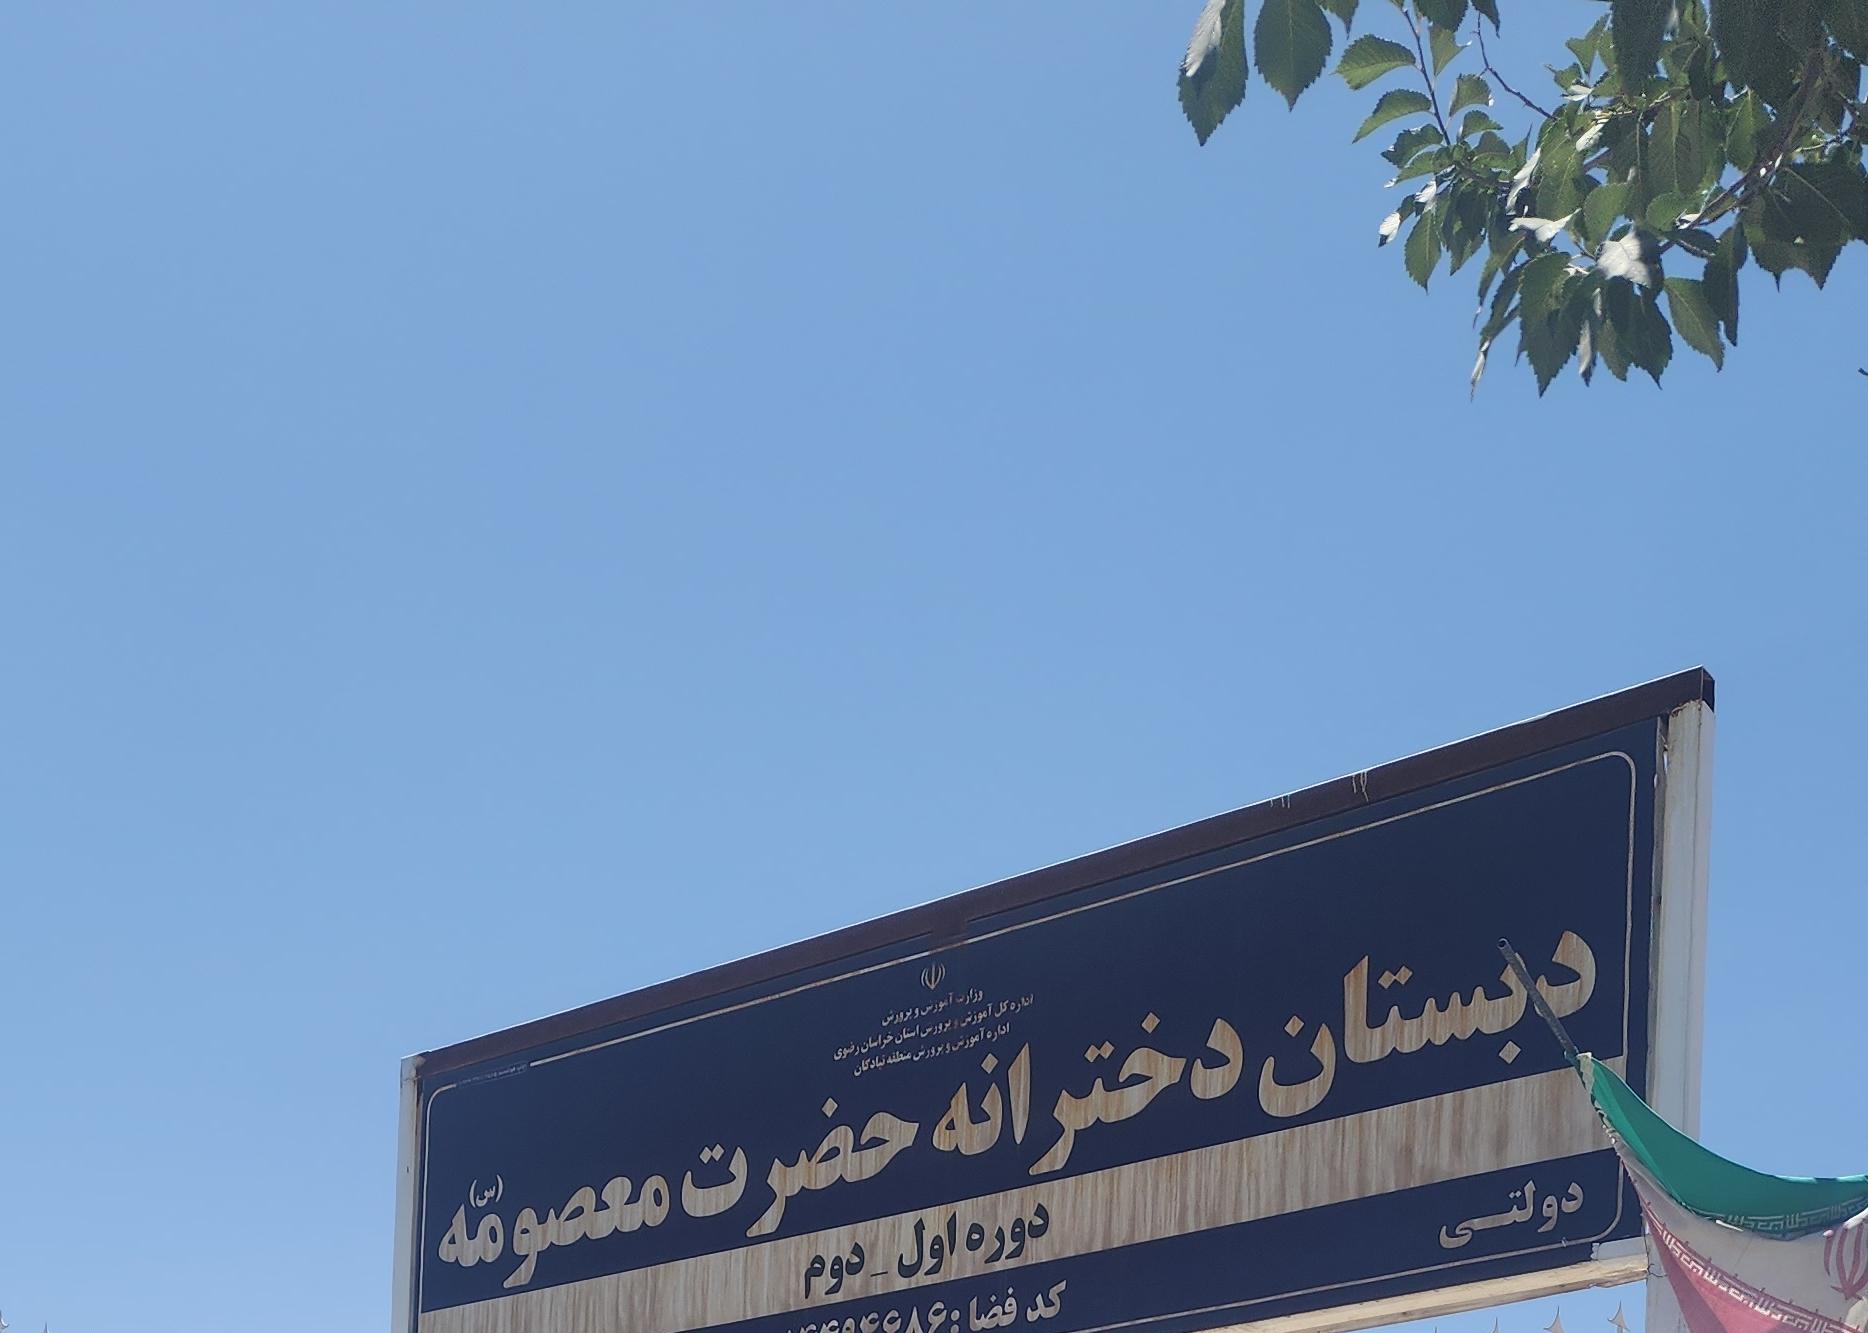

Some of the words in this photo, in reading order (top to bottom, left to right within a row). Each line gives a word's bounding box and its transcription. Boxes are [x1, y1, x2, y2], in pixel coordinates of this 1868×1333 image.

[986, 1021, 1010, 1041] اداره
[994, 1000, 1009, 1018] کل
[1258, 930, 1596, 1117] دبستان
[932, 1012, 1244, 1176] دخترانه
[681, 1096, 920, 1238] حضرت
[437, 1174, 671, 1289] معصومه
[897, 1210, 958, 1279] اول
[965, 1202, 1050, 1265] دوره
[804, 1241, 866, 1300] دوم
[1026, 1279, 1068, 1323] کد
[968, 1286, 1018, 1333] فضا
